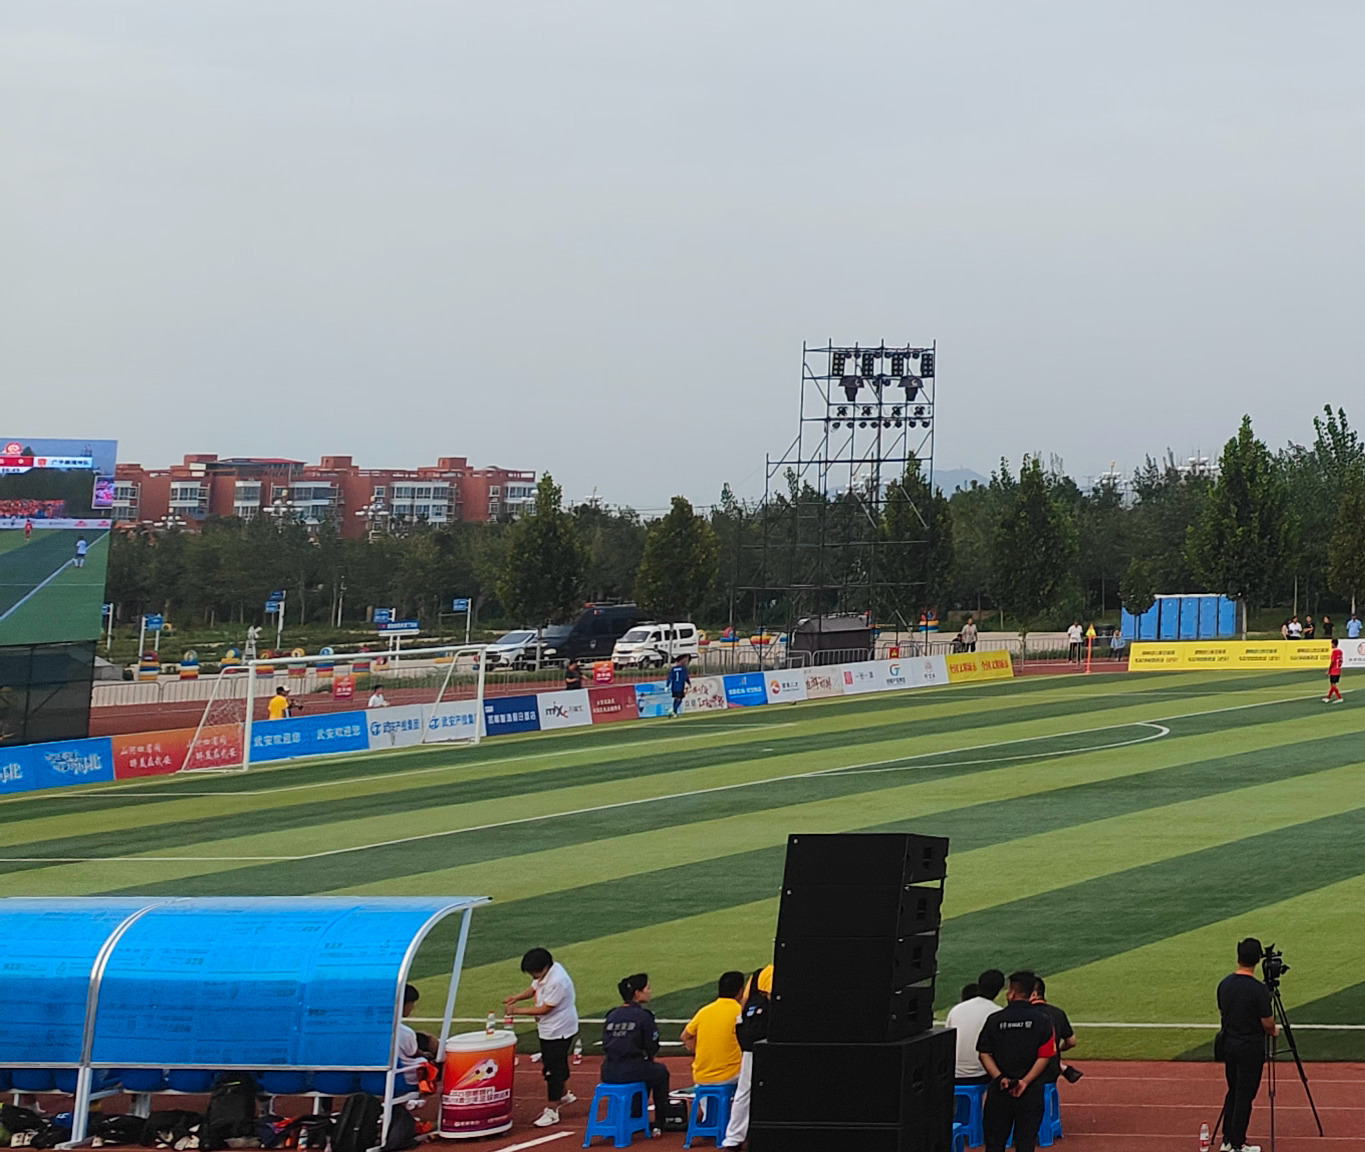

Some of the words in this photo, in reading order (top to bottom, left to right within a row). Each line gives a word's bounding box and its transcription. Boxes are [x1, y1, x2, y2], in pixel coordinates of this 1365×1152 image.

[441, 715, 476, 728] 武安产投集
[253, 732, 301, 747] 武安欢迎您
